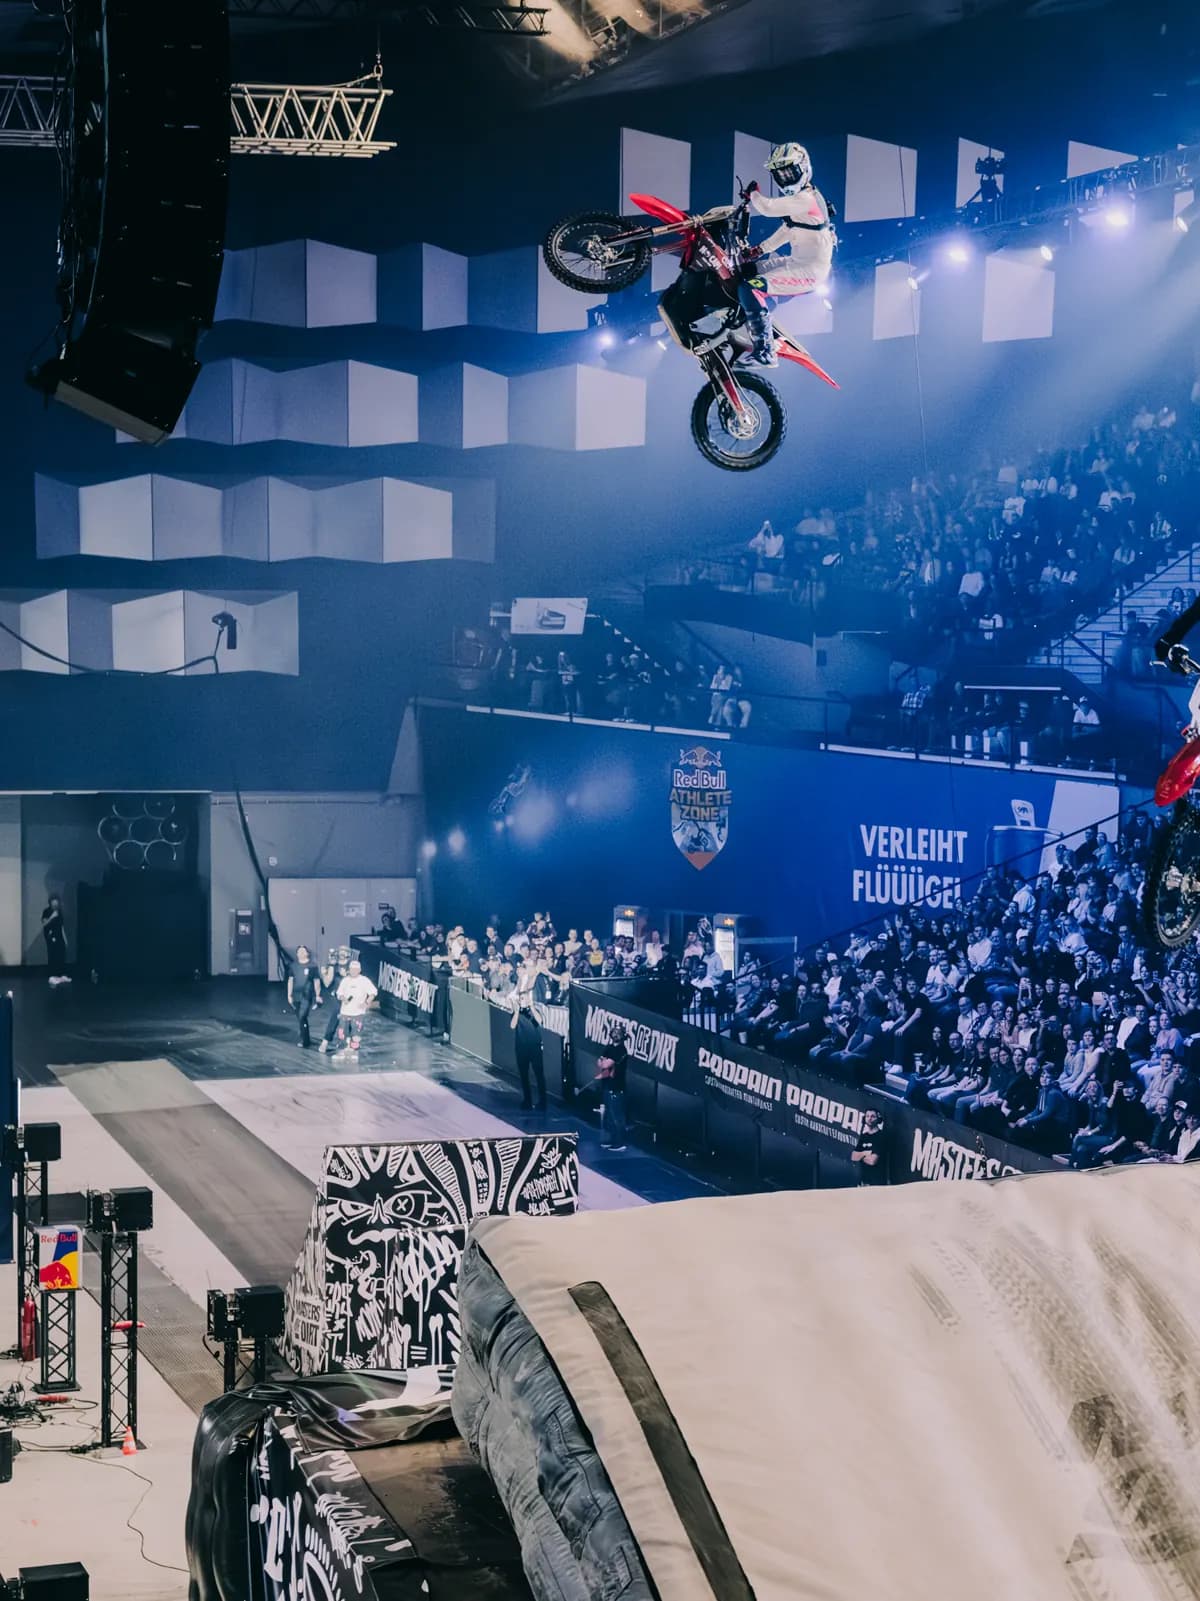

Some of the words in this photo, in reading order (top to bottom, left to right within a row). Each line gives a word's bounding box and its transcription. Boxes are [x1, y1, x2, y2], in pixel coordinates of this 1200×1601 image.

[674, 769, 699, 788] Red
[700, 770, 726, 789] Bull
[669, 788, 732, 805] ATHLETE
[680, 805, 720, 821] ZONE
[859, 824, 968, 864] VERLEIHT
[648, 1030, 679, 1072] DIRT
[698, 1047, 783, 1102] PROPAIN
[41, 1235, 58, 1243] Red
[60, 1233, 77, 1242] Bull
